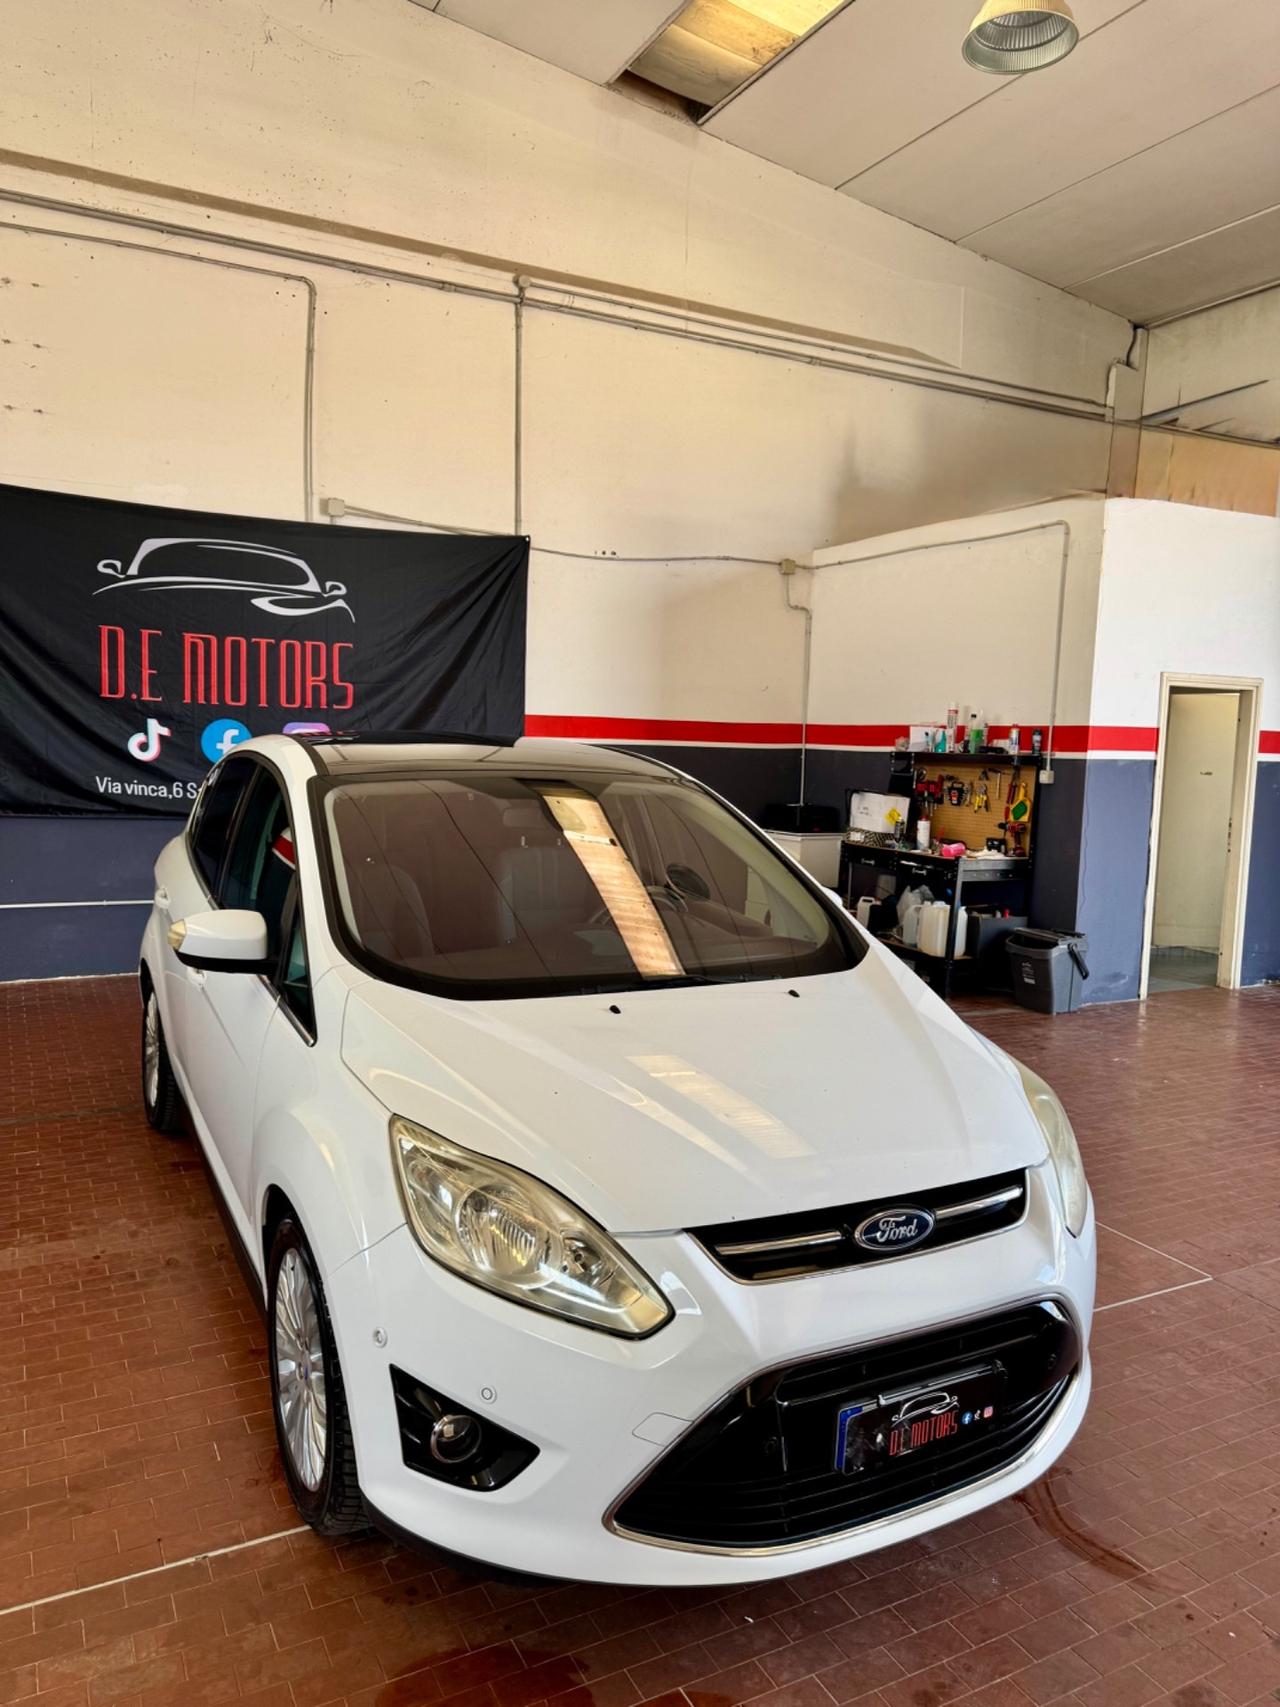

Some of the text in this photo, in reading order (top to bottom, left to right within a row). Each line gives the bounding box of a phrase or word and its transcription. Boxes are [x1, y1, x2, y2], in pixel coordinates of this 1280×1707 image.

[98, 625, 354, 709] D.E MOTORS
[95, 775, 122, 794] Via
[875, 1215, 919, 1243] Ford
[910, 1410, 959, 1449] MOTORS
